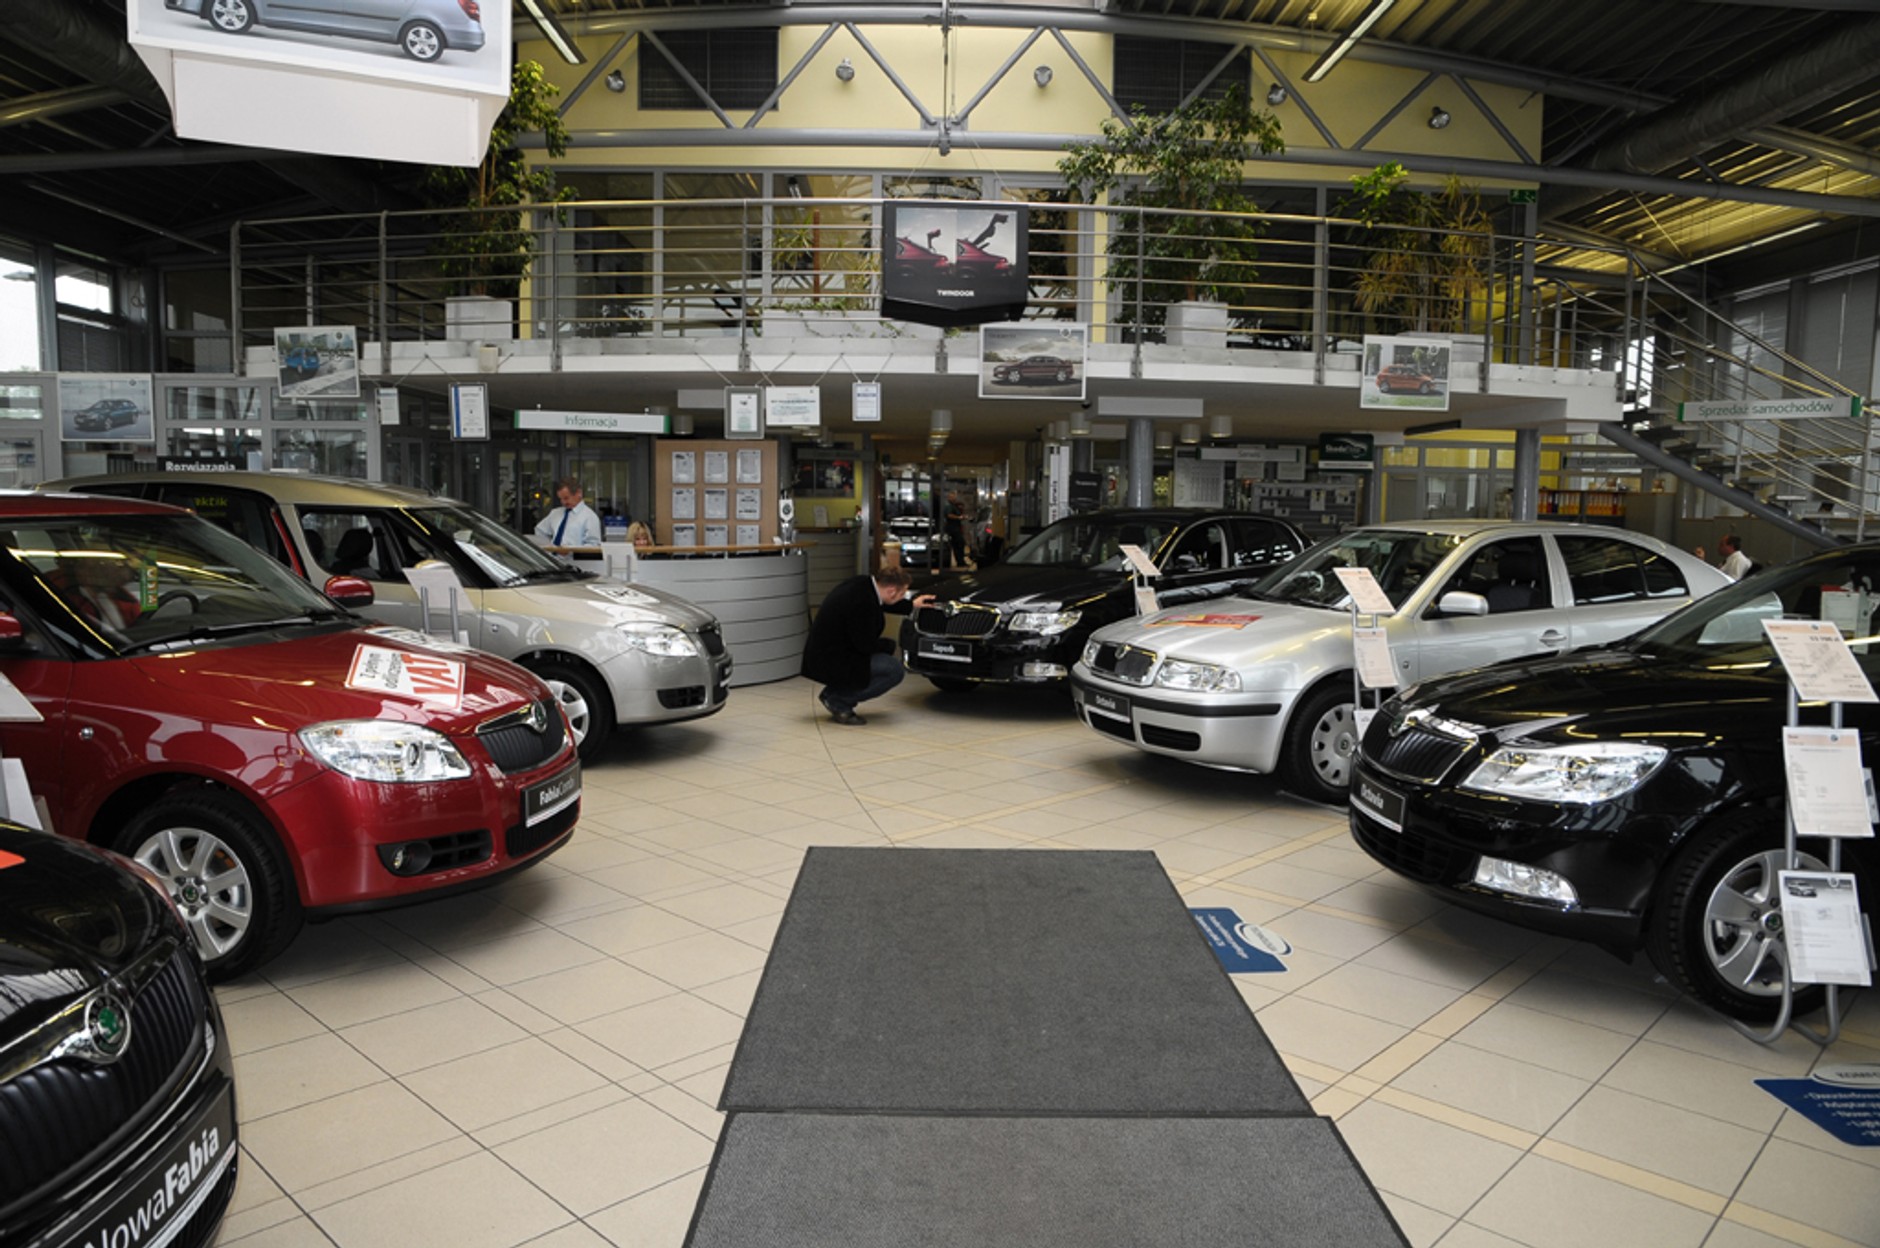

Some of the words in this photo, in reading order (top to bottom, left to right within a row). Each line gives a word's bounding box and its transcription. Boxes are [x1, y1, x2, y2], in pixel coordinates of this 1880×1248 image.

[936, 289, 975, 297] TWINDOOR
[1698, 403, 1748, 418] Sprzedaż
[1752, 400, 1834, 415] samochodów
[565, 415, 618, 429] Informacja
[400, 653, 460, 694] VAT
[1361, 783, 1384, 809] Octavia
